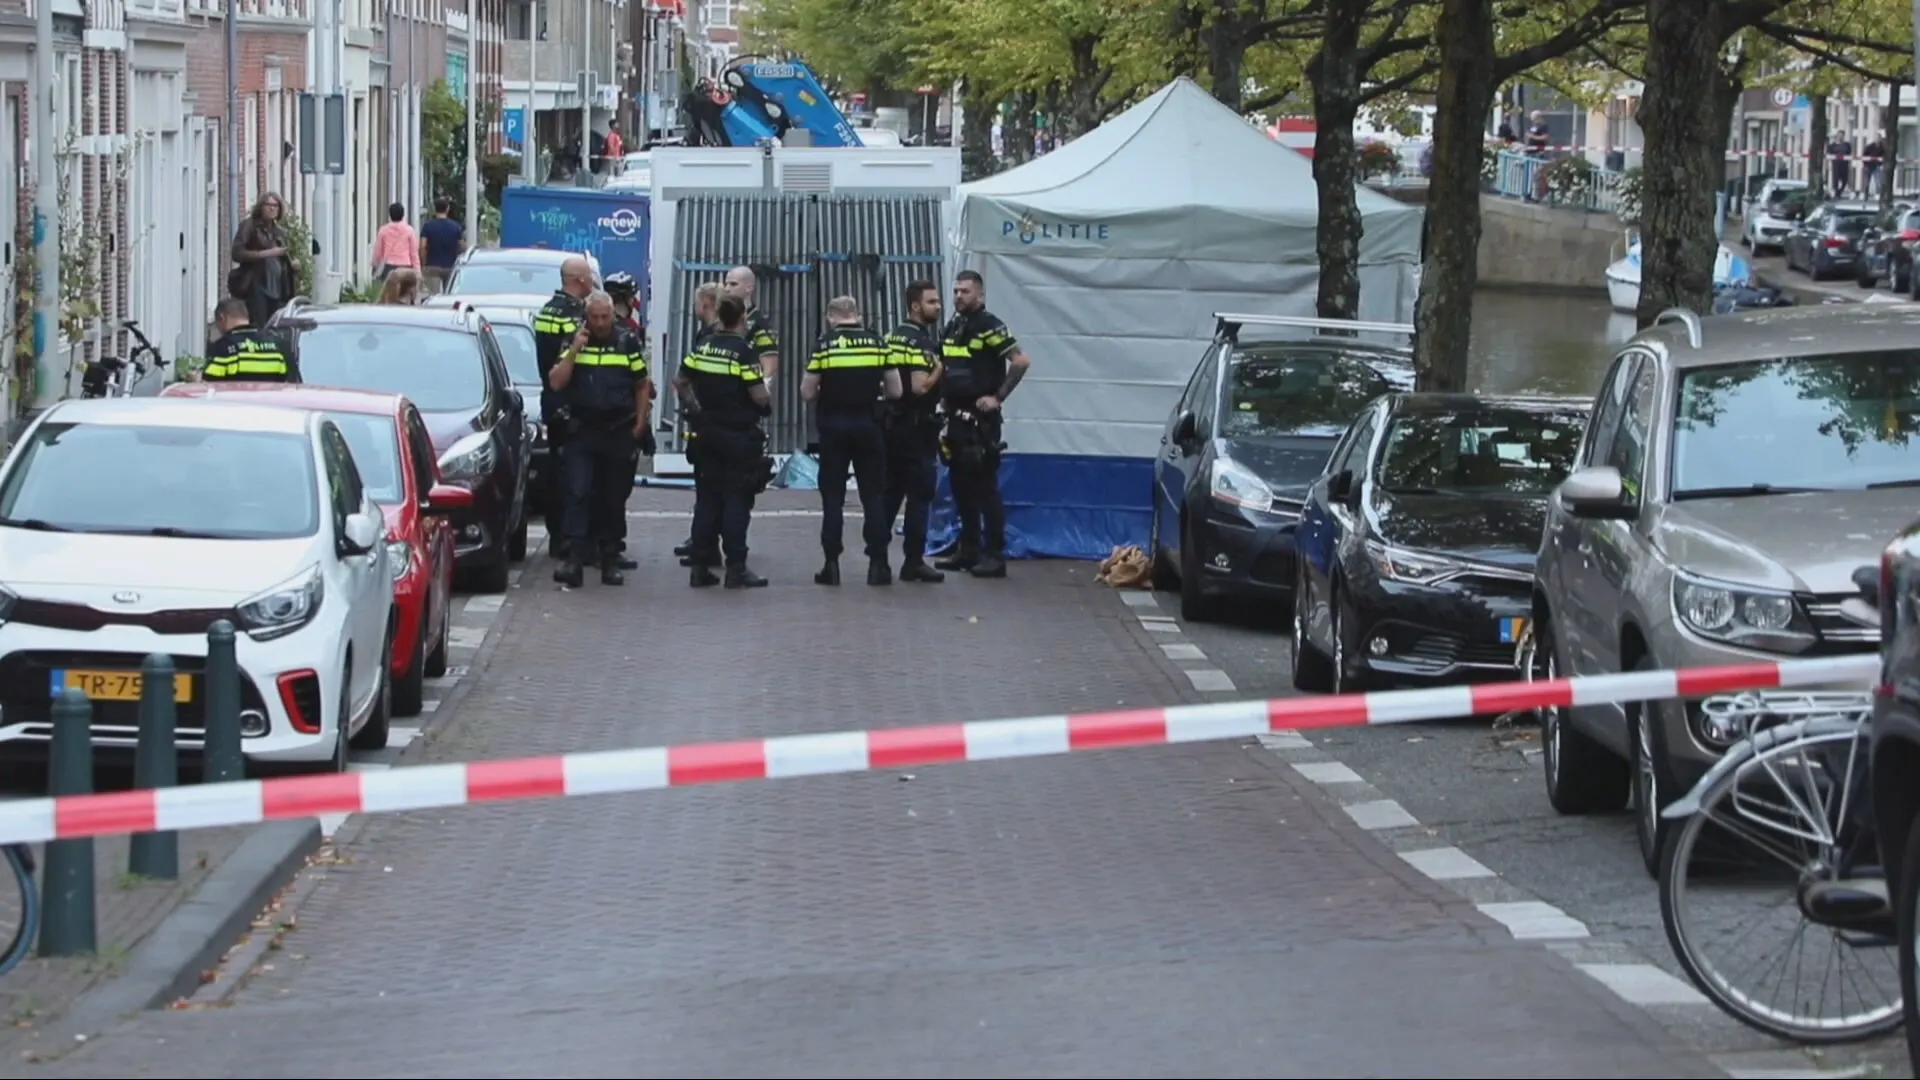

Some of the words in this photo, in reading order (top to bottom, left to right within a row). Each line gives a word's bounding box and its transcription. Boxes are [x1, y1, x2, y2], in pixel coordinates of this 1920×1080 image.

[757, 66, 792, 76] FASSI
[507, 118, 517, 134] P
[597, 215, 642, 229] renewi
[1002, 216, 1109, 245] POLITIE
